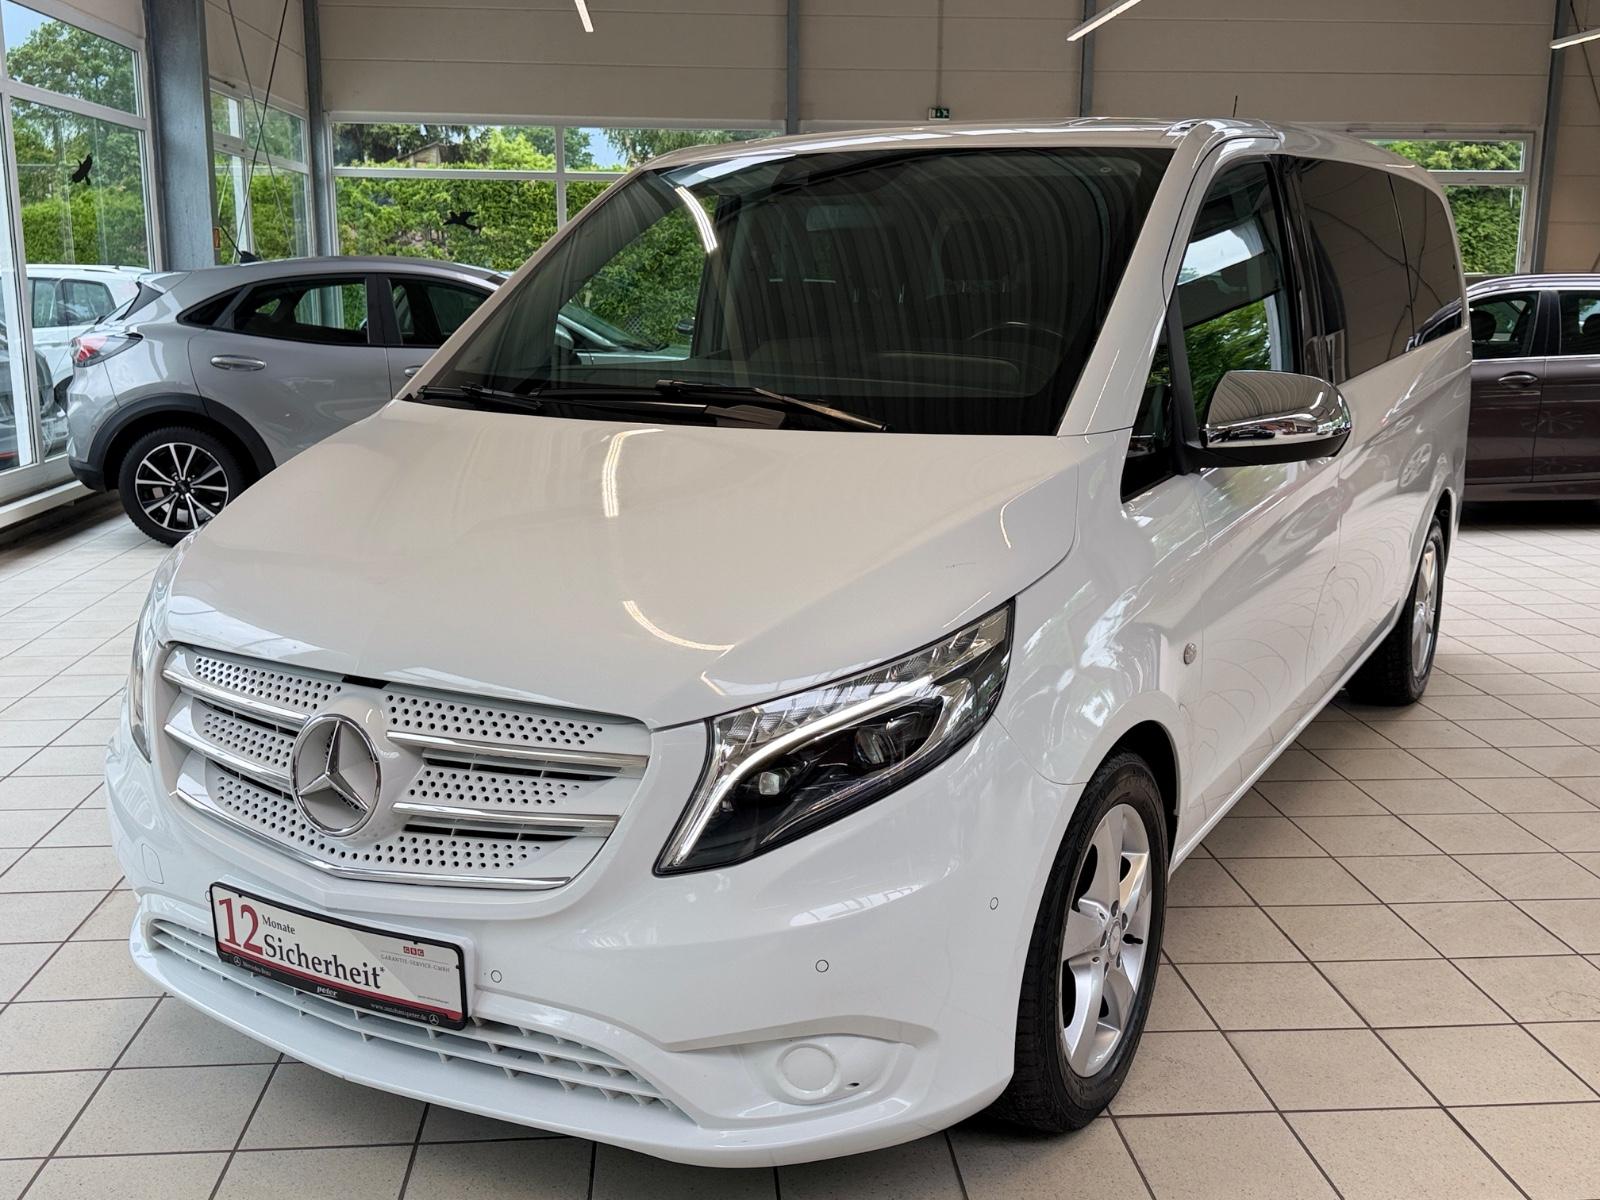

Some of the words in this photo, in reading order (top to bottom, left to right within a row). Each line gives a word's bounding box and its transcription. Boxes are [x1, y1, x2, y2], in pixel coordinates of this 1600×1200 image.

[218, 898, 264, 956] 12
[262, 914, 296, 935] Monate
[316, 985, 338, 996] peter
